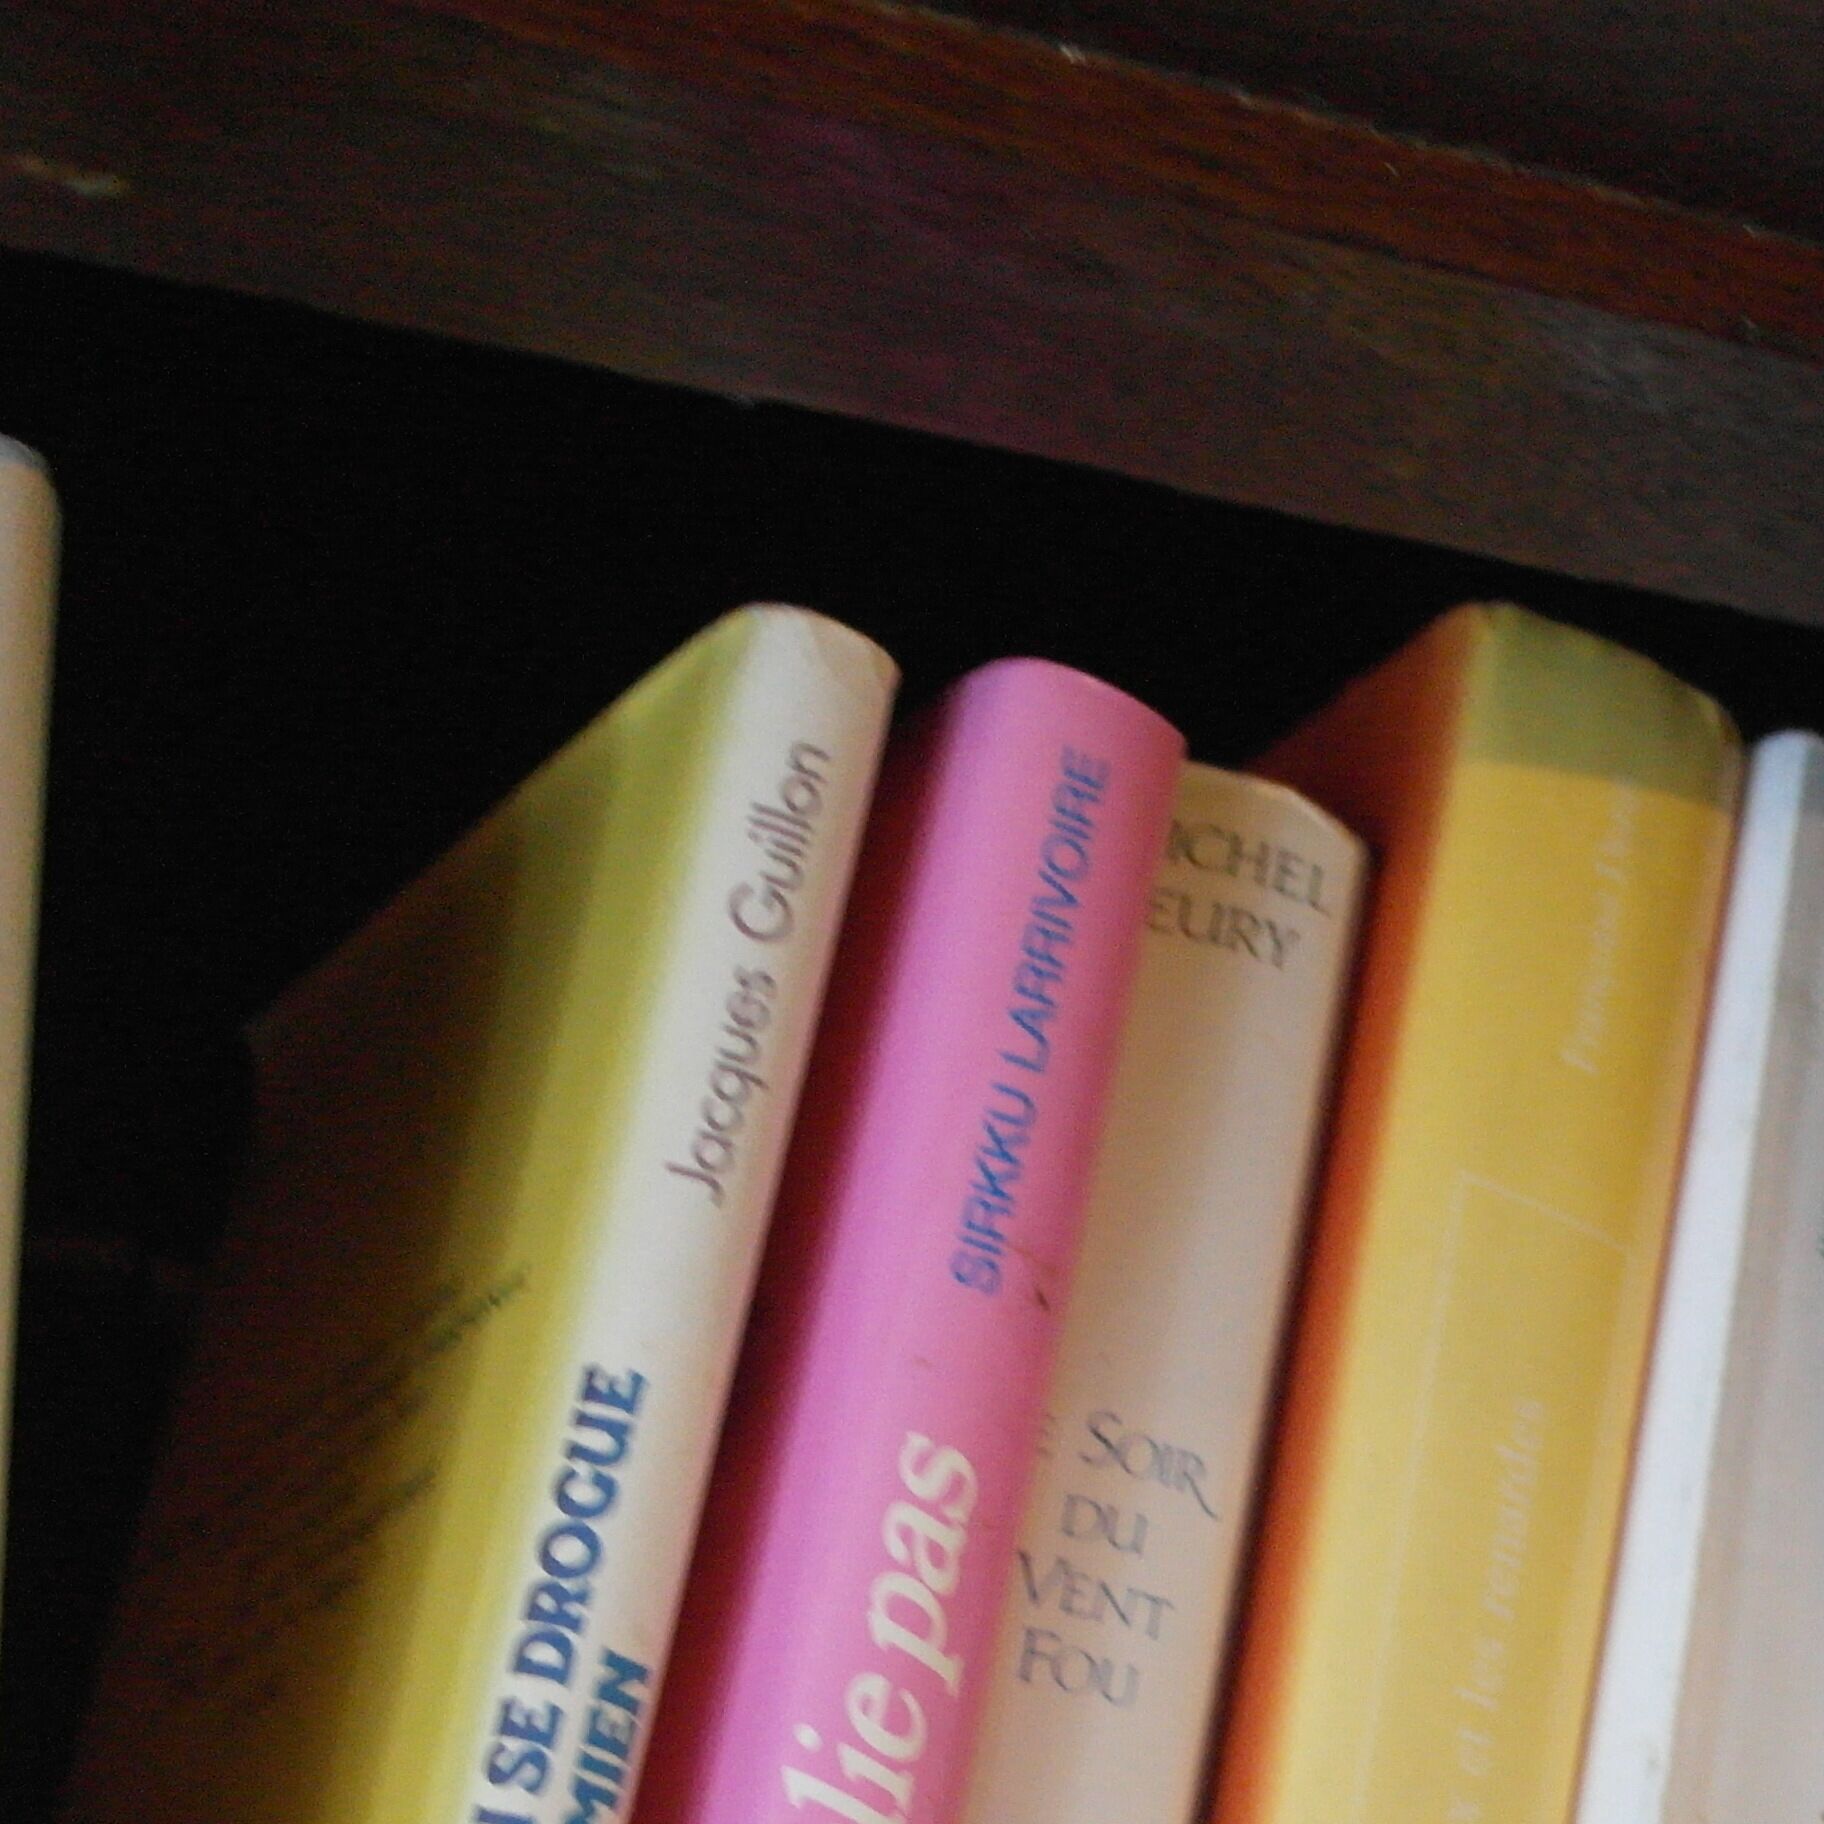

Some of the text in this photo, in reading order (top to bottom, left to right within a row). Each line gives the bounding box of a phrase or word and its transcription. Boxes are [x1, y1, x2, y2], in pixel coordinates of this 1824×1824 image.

[1165, 818, 1331, 920] ICHEL
[665, 740, 831, 1207] Jacques Guillon
[1146, 886, 1302, 971] EURY
[951, 744, 1111, 1296] SIRKKU LARRIVOIRE
[1077, 1410, 1217, 1520] SOIR
[510, 1363, 648, 1690] DROGUE
[866, 1430, 980, 1699] pas
[1062, 1493, 1148, 1556] DU
[1017, 1548, 1176, 1640] VENT
[1016, 1625, 1140, 1708] FOU
[484, 1699, 566, 1795] SE
